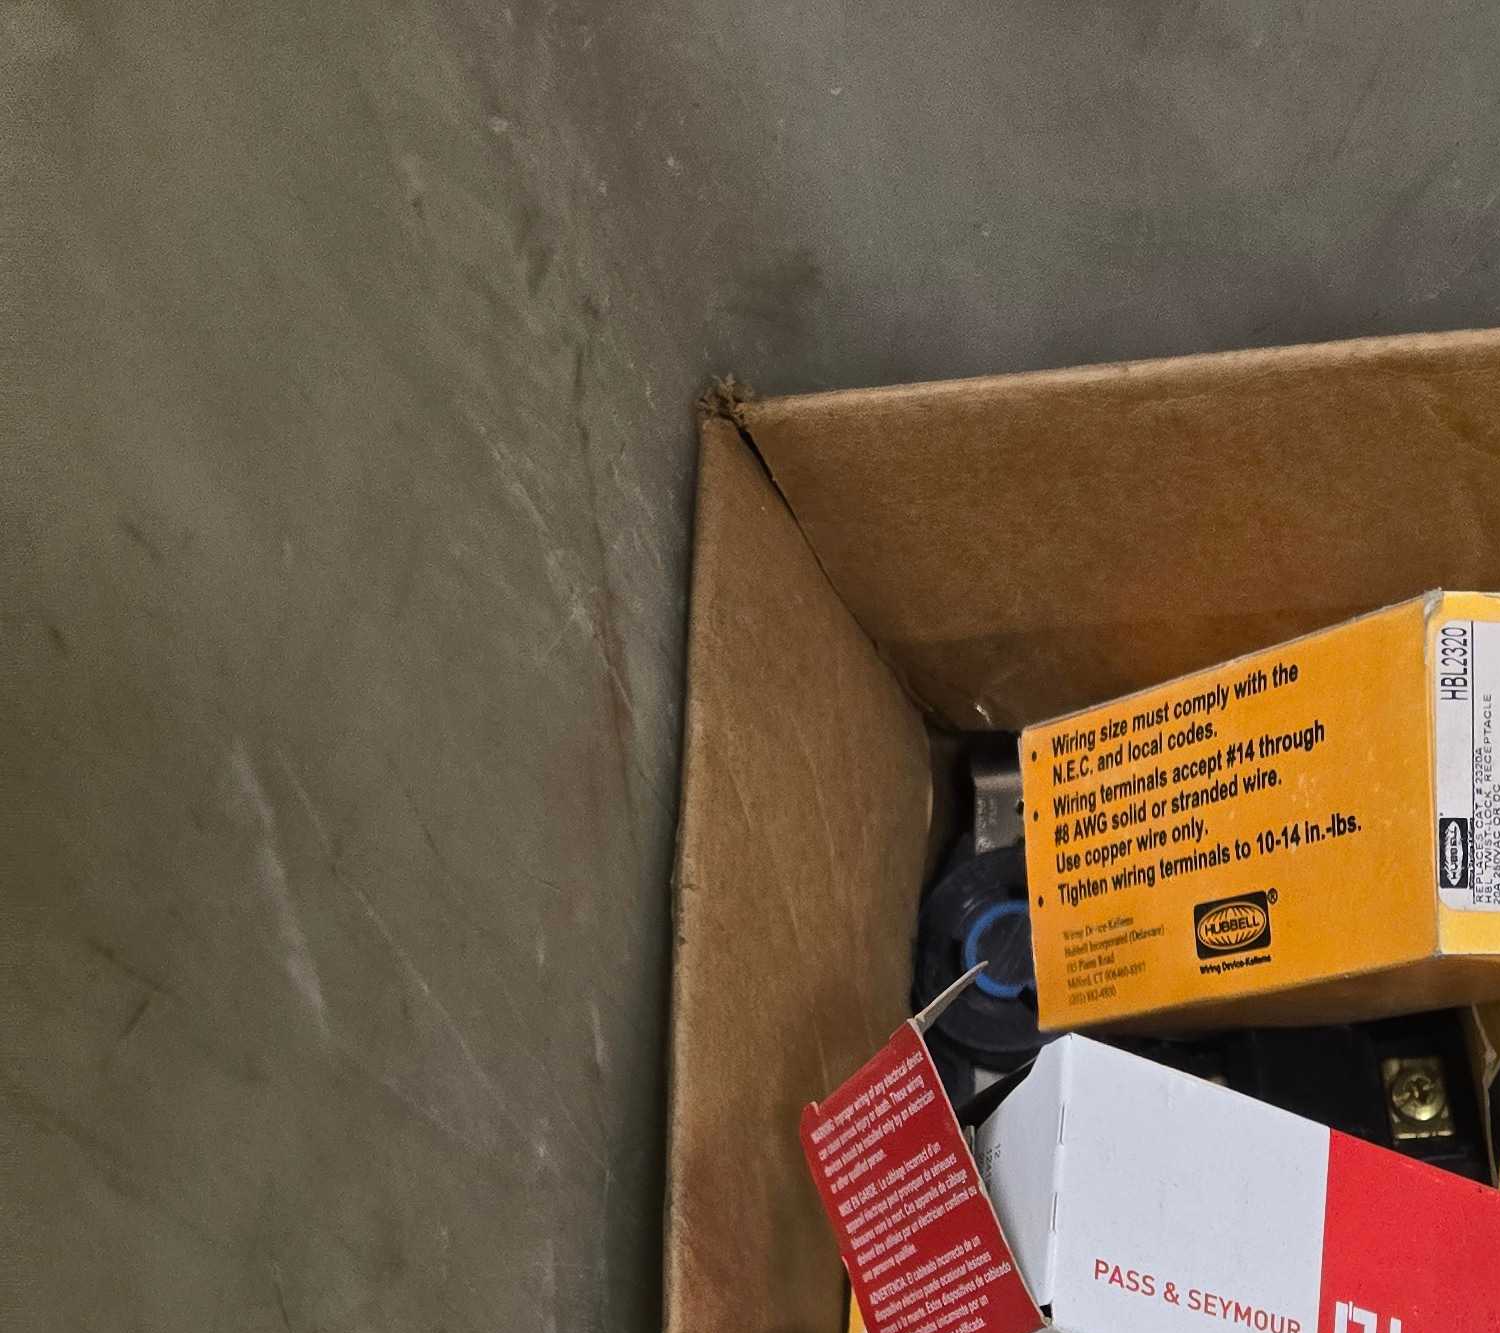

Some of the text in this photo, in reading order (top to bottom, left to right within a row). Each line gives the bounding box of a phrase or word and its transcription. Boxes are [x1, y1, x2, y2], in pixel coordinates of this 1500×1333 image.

[1440, 627, 1469, 700] HBL2320
[1052, 663, 1298, 758] Wiring size must comply with the
[1053, 720, 1217, 786] N.E.C. and local codes.
[1053, 720, 1324, 818] Wiring terminals accept #14 through
[1055, 768, 1281, 847] #8 AWG solid or stranded wire.
[1056, 817, 1208, 874] Use copper wire only.
[1058, 813, 1361, 905] Tighten wiring terminals to 10-14 in.-lbs.
[1205, 916, 1259, 937] HUBBELL
[1094, 1258, 1155, 1297] PASS
[1163, 1280, 1180, 1305] &
